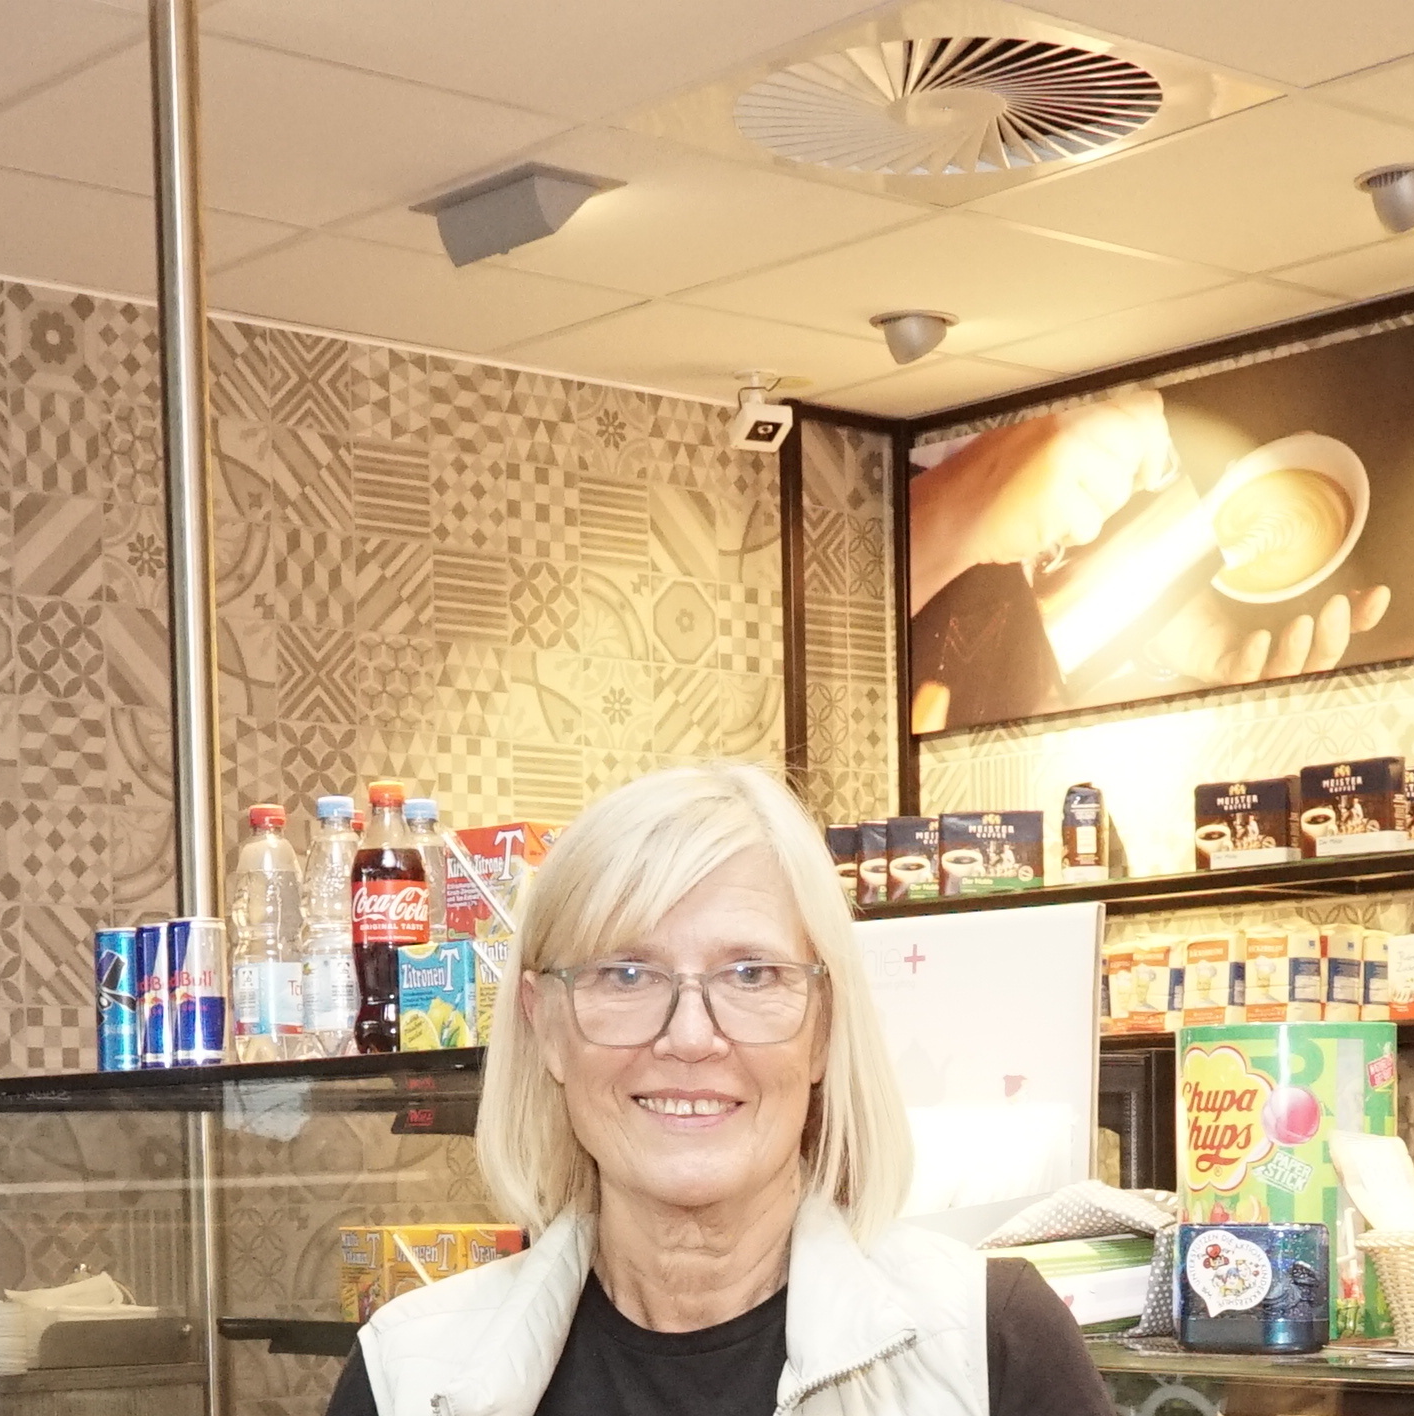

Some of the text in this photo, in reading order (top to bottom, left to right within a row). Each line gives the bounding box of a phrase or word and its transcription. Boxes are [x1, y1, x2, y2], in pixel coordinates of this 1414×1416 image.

[353, 886, 429, 922] Coca-Cola
[359, 923, 424, 932] ORIGINAL TASTE
[401, 963, 445, 989] Zitronen
[1183, 1082, 1258, 1122] Chupa
[1261, 1161, 1308, 1192] STICK
[1274, 1150, 1312, 1176] PAPER
